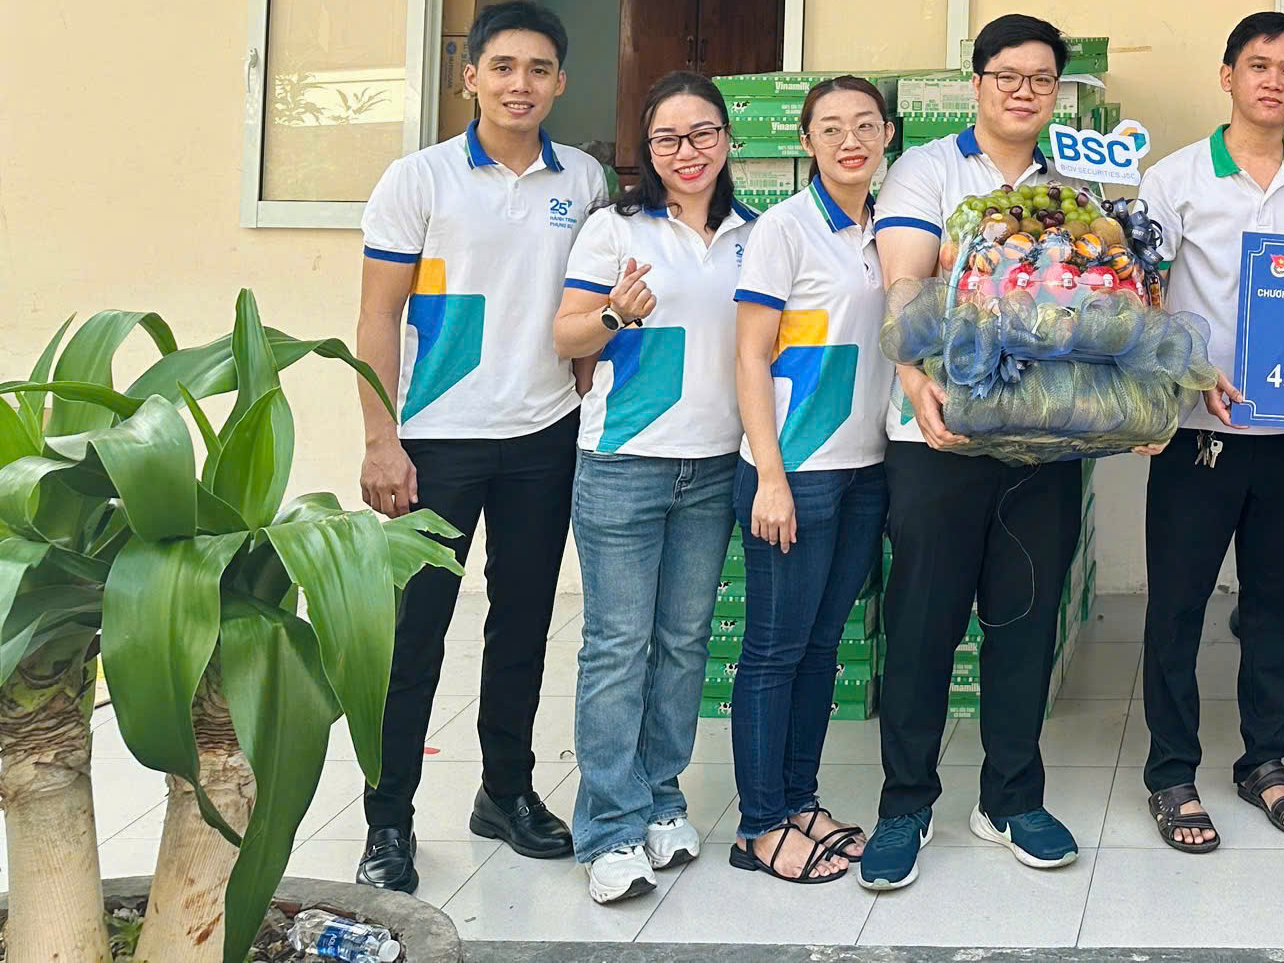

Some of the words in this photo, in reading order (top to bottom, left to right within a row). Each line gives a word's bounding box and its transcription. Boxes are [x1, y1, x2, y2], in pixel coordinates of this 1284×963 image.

[775, 82, 809, 91] Vinamilk
[772, 122, 798, 131] Vinam
[1055, 131, 1132, 167] BSC
[550, 198, 568, 215] 25
[735, 243, 744, 255] 2
